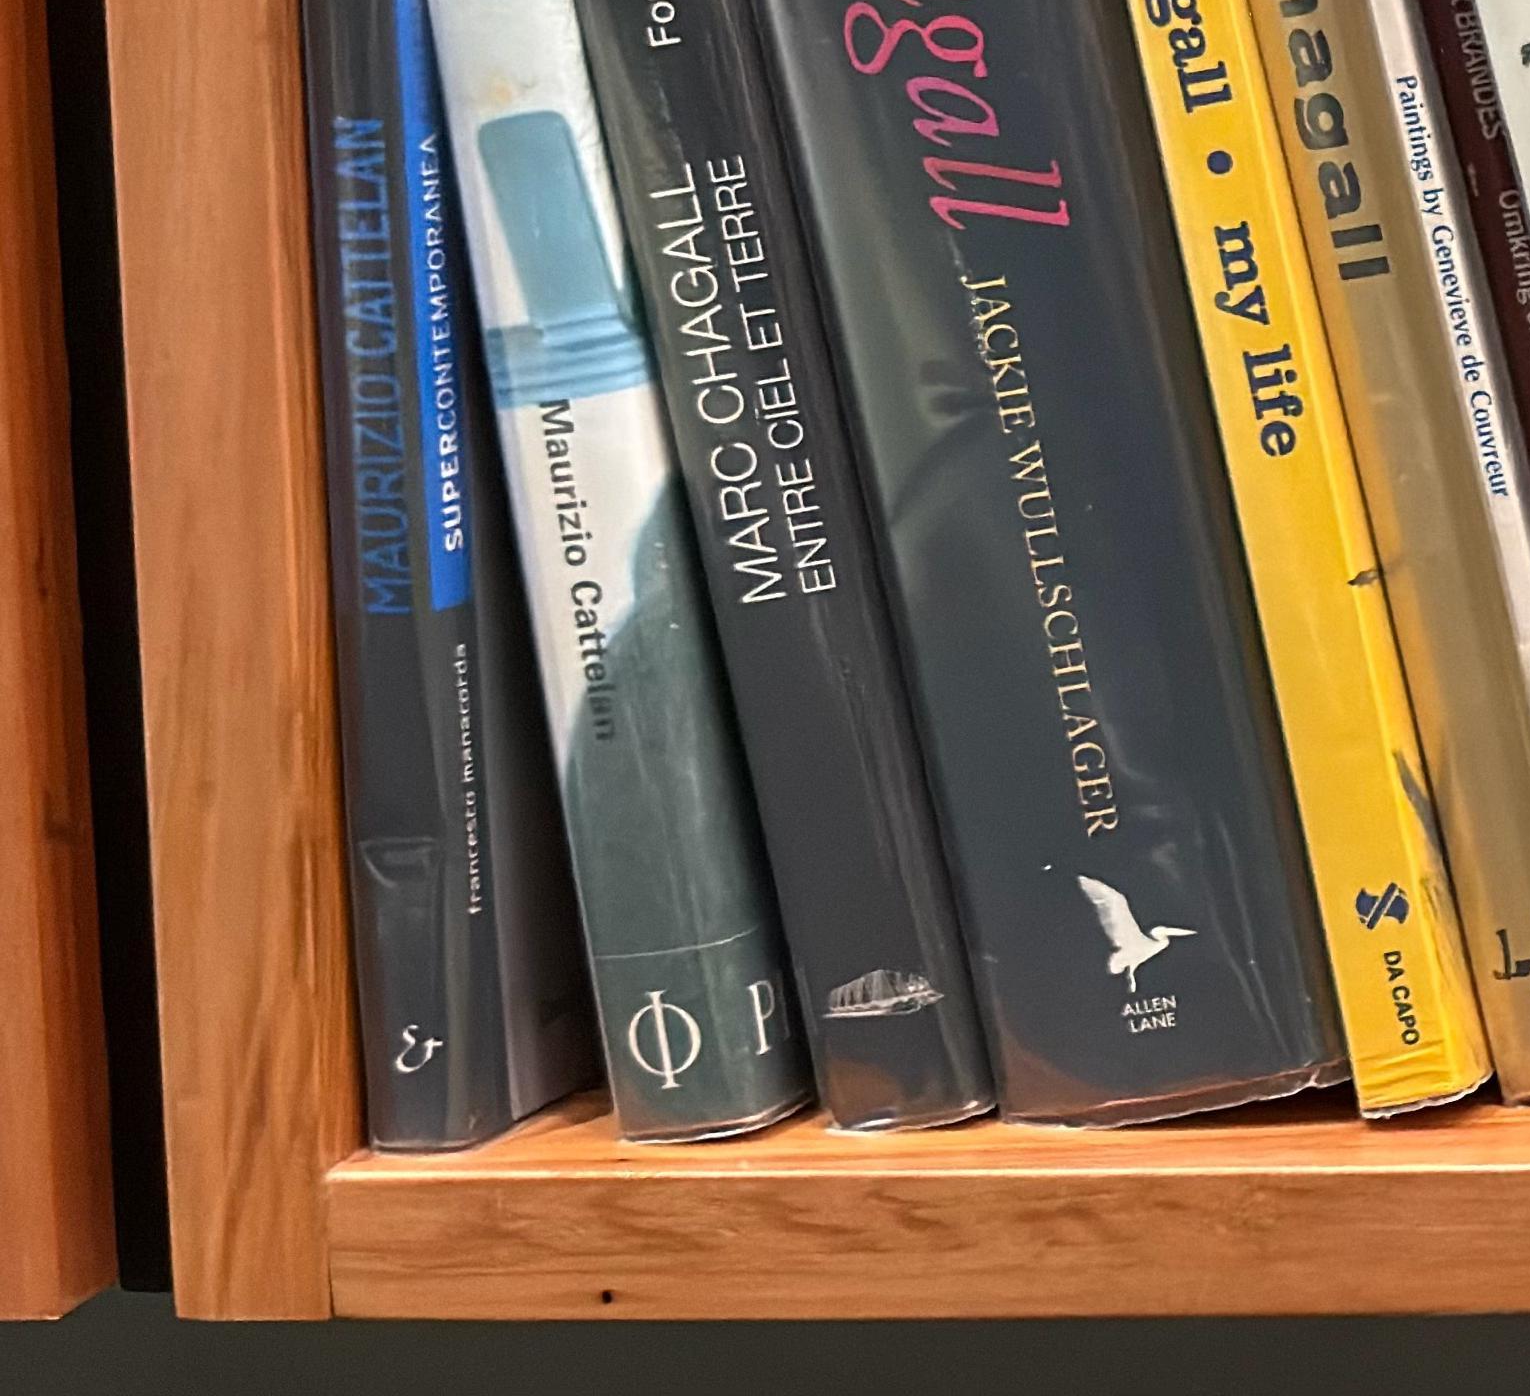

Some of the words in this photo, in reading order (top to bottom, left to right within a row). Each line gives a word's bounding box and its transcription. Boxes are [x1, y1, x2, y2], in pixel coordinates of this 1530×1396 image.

[1395, 75, 1431, 183] Paintings
[336, 116, 397, 356] CATTELAN
[708, 155, 768, 293] TERRE
[1423, 187, 1443, 218] by
[418, 134, 464, 551] SUPERCONTEMPORANEA
[650, 162, 745, 425] CHAGALL
[741, 313, 783, 351] ET
[1213, 220, 1270, 326] my
[1243, 344, 1303, 459] life
[1431, 224, 1473, 349] Genevieve
[754, 358, 805, 449] CIEL
[1460, 355, 1481, 383] de
[352, 372, 411, 614] MAURIZIO
[1469, 388, 1509, 499] Couvreur
[539, 400, 589, 567] Maurizio
[569, 580, 617, 741] Cattelan
[711, 440, 786, 604] MARC
[779, 457, 836, 594] ENTRE
[961, 274, 1037, 435] JACKIE
[1009, 442, 1120, 838] WULLSCHLAGER
[1121, 995, 1178, 1018] ALLEN
[1128, 1011, 1177, 1033] LANE
[1382, 949, 1408, 986] DA
[1389, 985, 1420, 1047] CAPO
